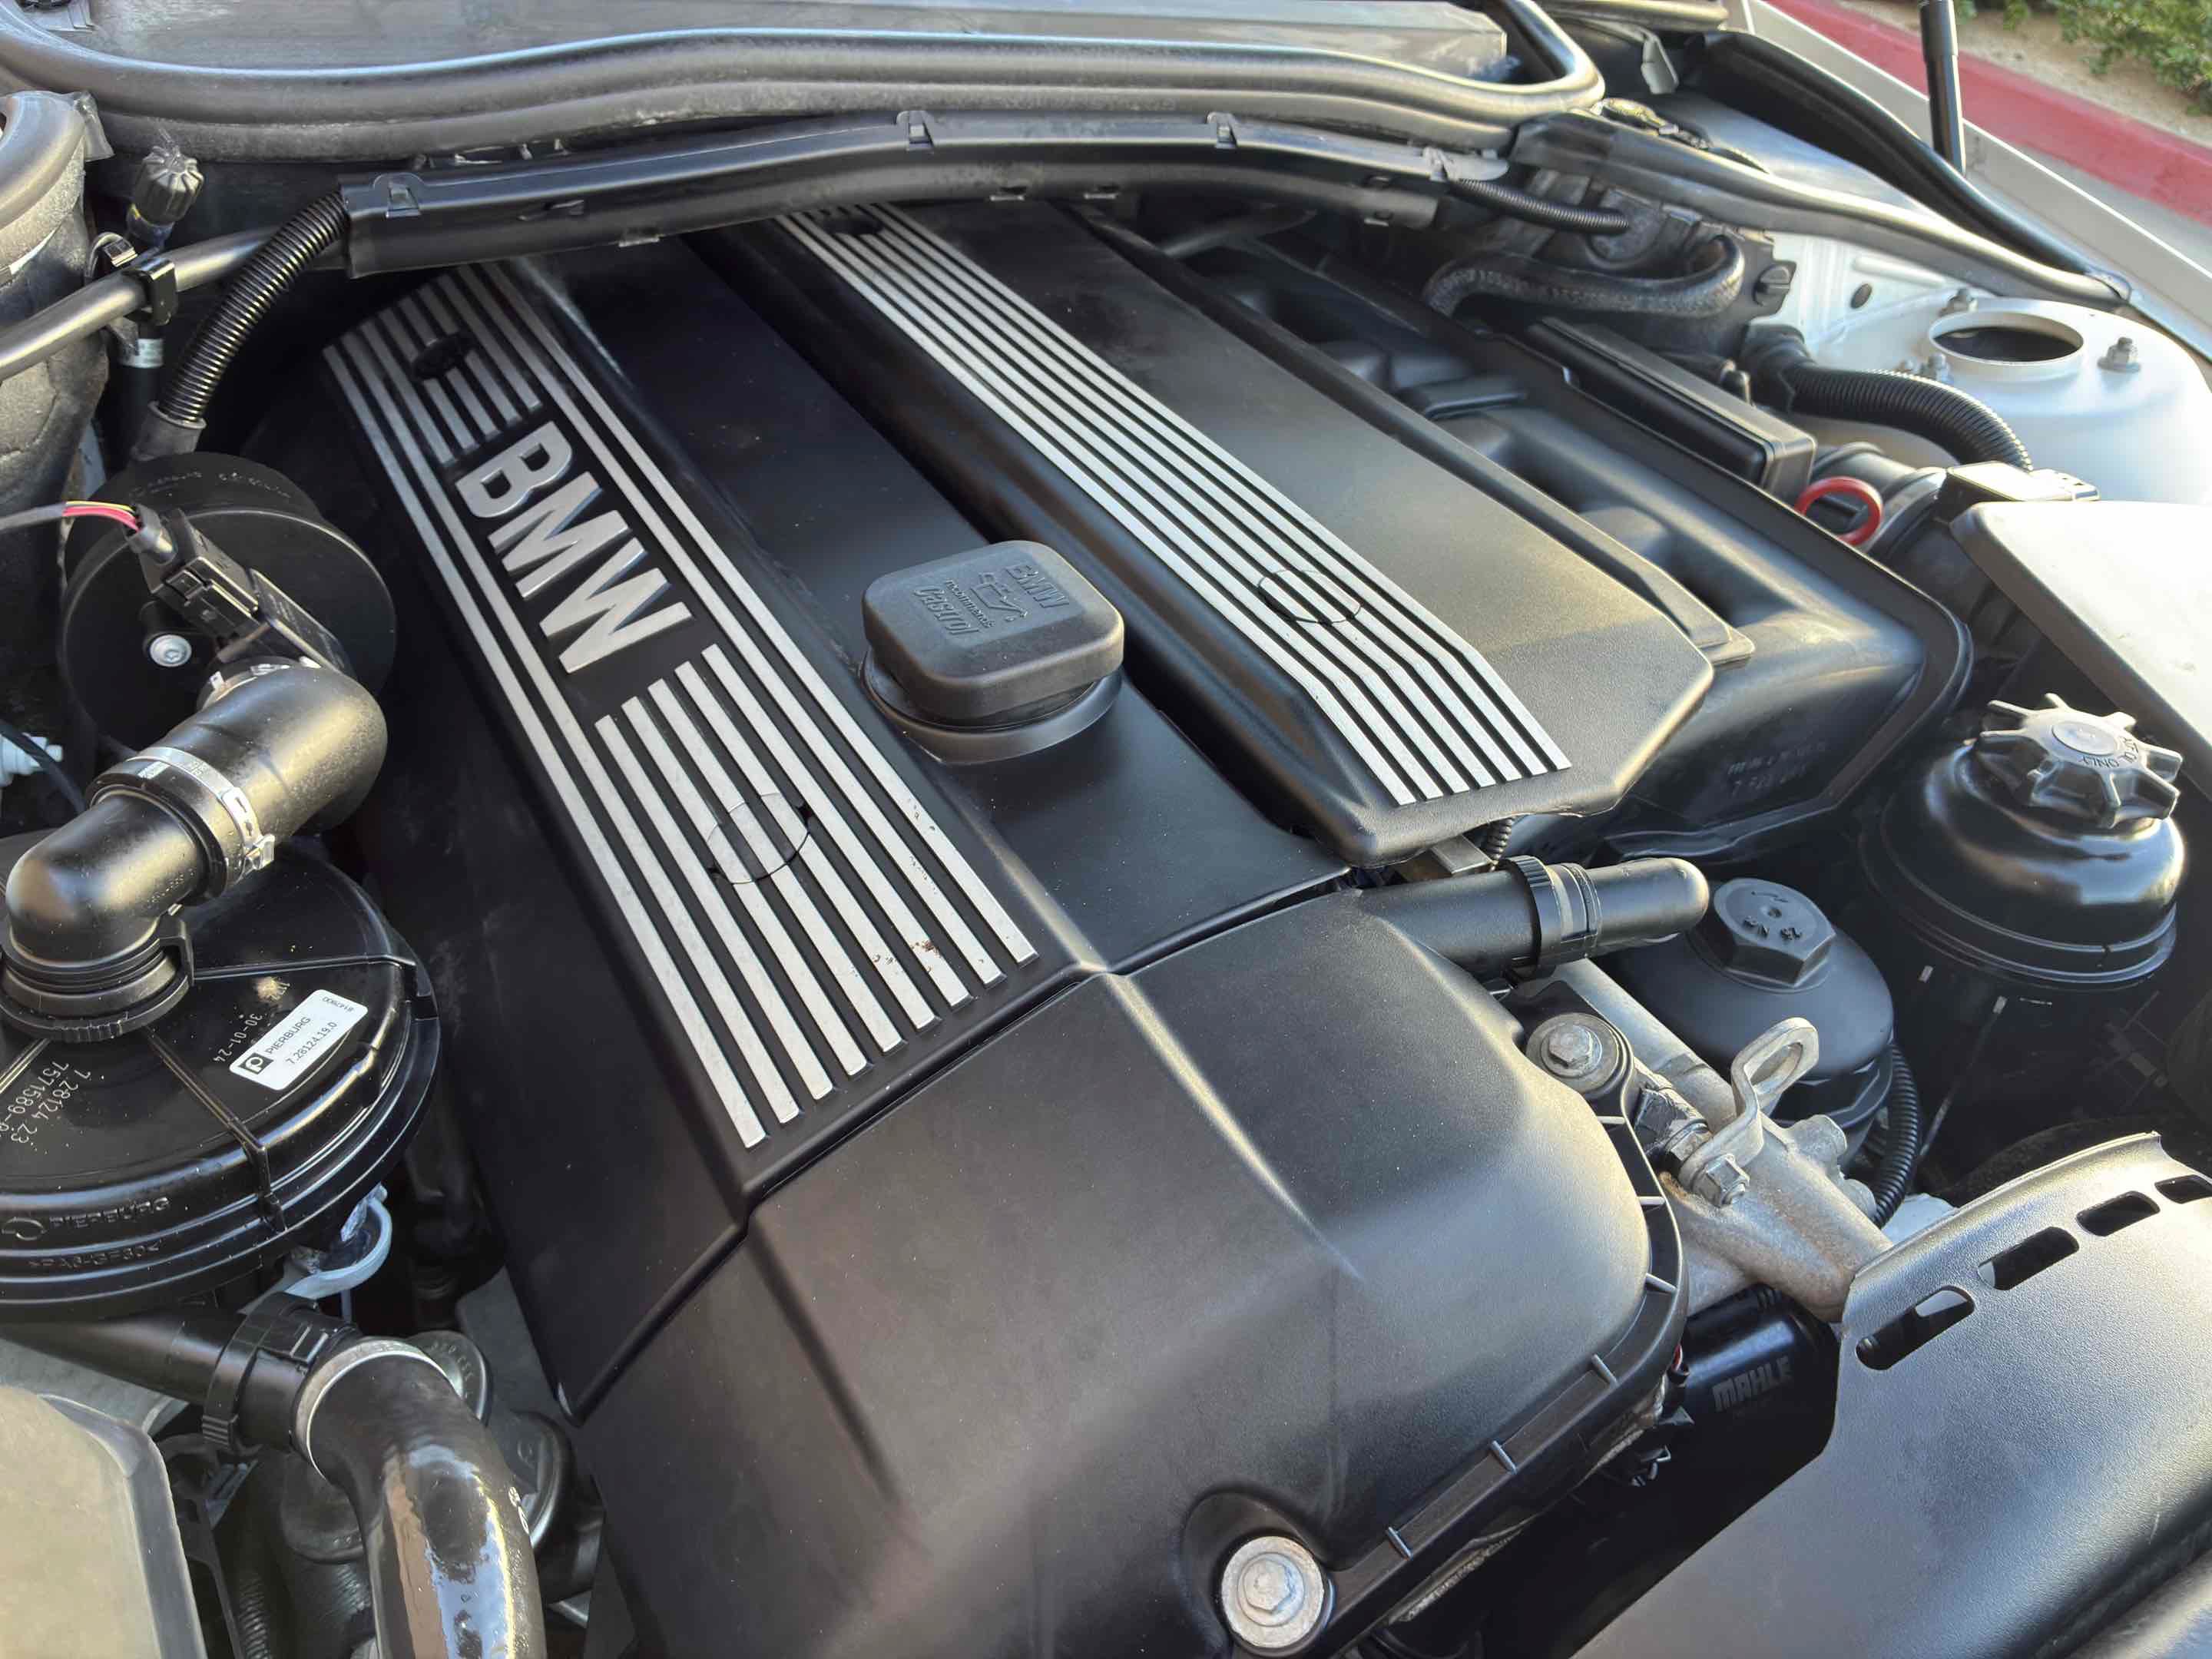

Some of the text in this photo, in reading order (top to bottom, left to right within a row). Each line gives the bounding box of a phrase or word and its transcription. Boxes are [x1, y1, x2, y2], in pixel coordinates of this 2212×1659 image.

[455, 421, 693, 674] BMW
[945, 580, 996, 628] recommends
[1005, 565, 1070, 608] BMW
[913, 586, 981, 636] Castrol
[2081, 754, 2120, 768] ONLY
[213, 1013, 263, 1063] 30-01-24
[264, 1015, 312, 1055] PIERBURG
[284, 1021, 338, 1065] 7.28124.19.0
[1712, 1355, 1790, 1412] MAHLE
